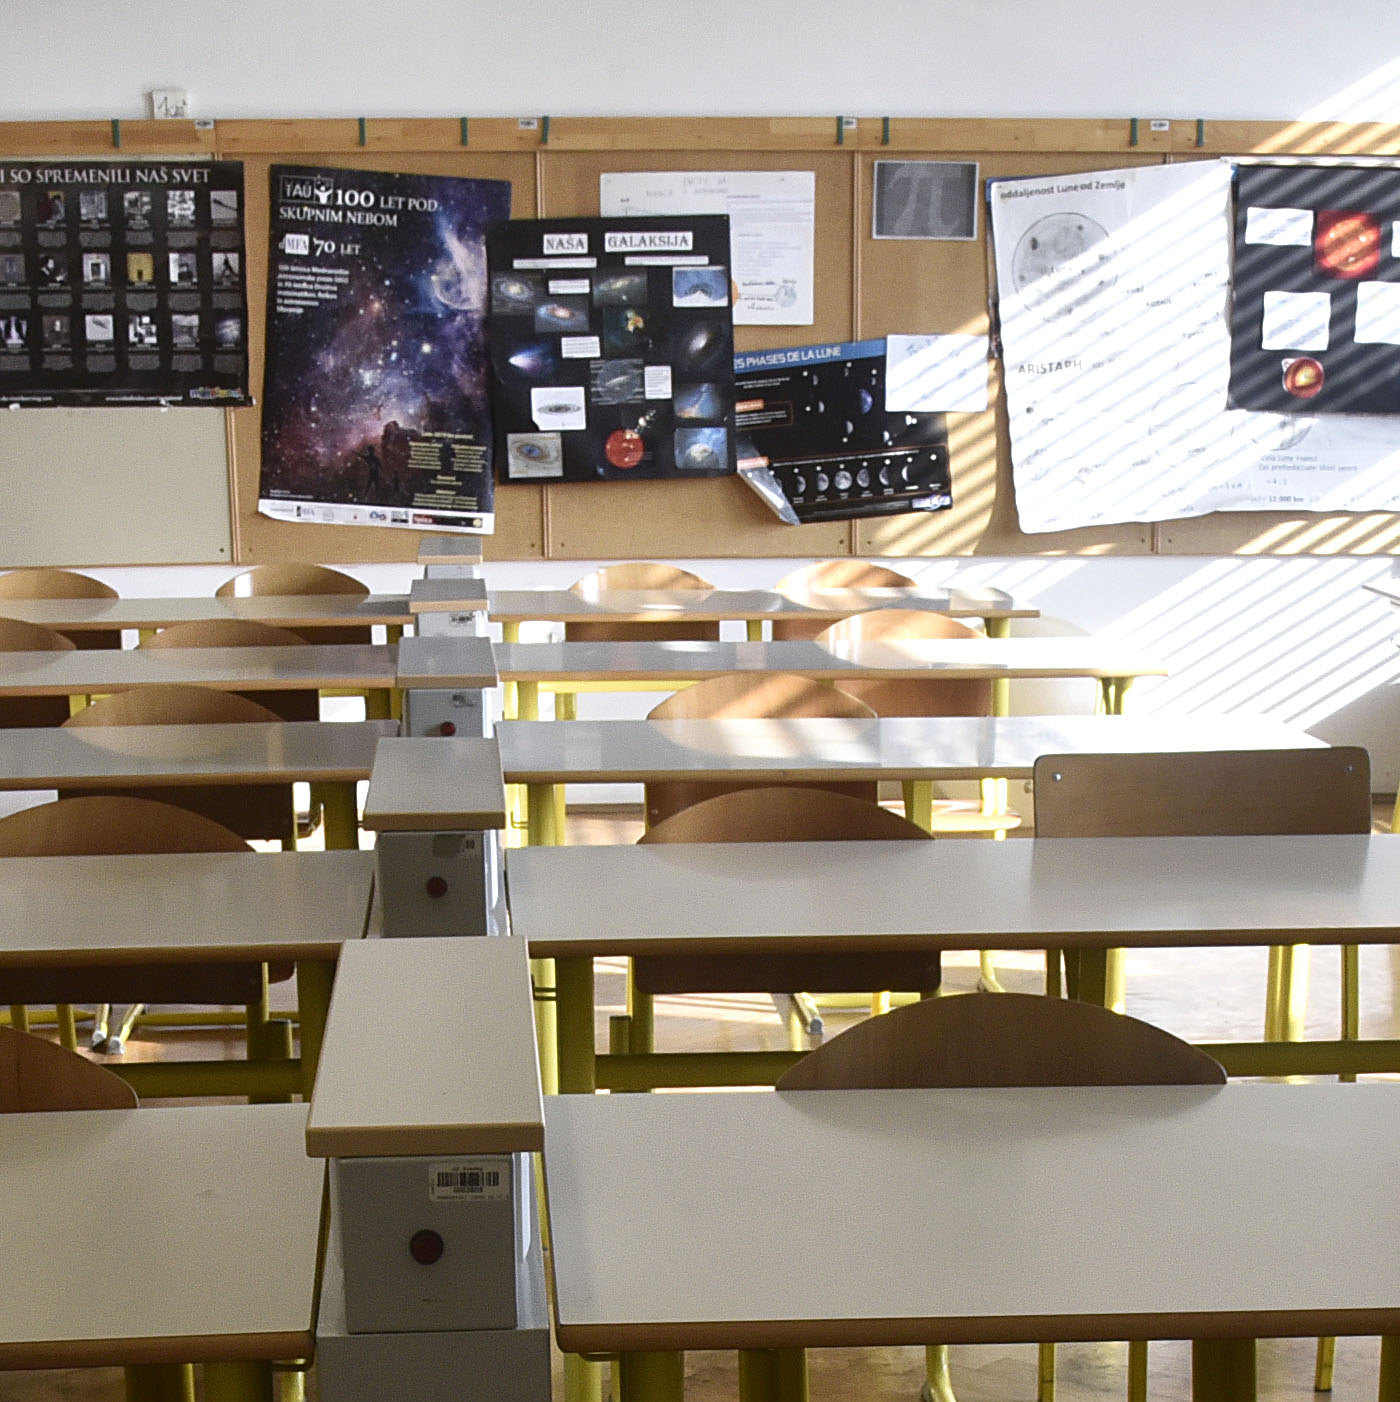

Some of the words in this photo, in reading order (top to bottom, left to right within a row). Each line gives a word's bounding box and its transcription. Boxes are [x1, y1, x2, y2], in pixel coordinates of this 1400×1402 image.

[10, 169, 32, 183] SO
[36, 168, 131, 183] SPREMENILI
[136, 166, 168, 183] NAŠ
[172, 168, 211, 183] SVET
[1000, 186, 1055, 199] oddaljenost
[1056, 184, 1078, 193] Lune
[1080, 182, 1092, 190] od
[1095, 180, 1125, 190] Zemlje
[335, 189, 375, 208] 100
[380, 197, 403, 209] LET
[408, 198, 439, 212] POD
[279, 207, 343, 222] SKUPNIM
[346, 212, 398, 227] NEBOM
[340, 243, 361, 255] LET
[546, 235, 585, 250] NAŠA
[608, 233, 690, 248] GALAKSIJA
[746, 354, 786, 368] PHASES
[787, 351, 800, 362] DE
[801, 349, 815, 361] LA
[816, 346, 841, 359] LUNE
